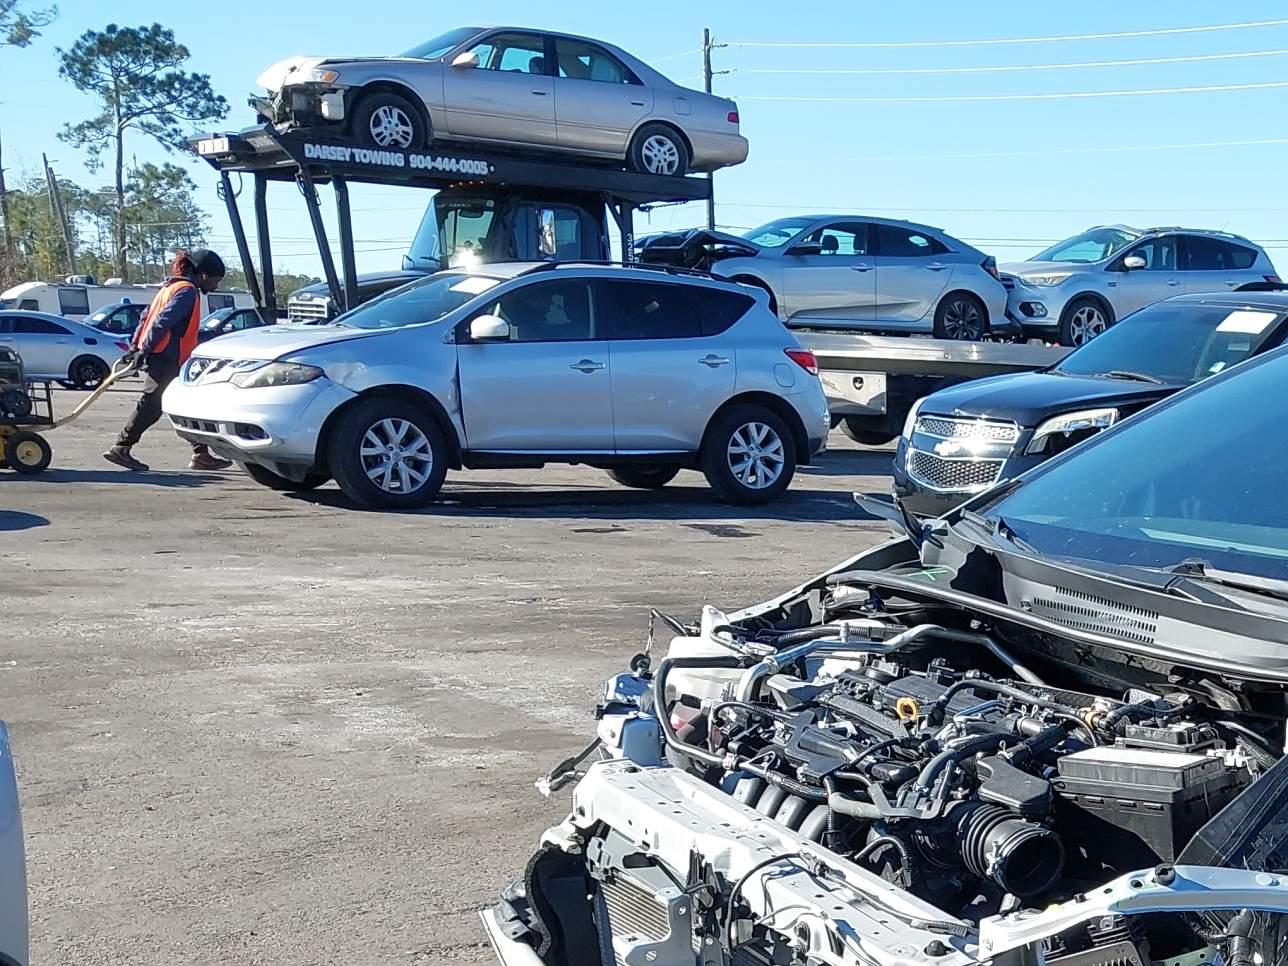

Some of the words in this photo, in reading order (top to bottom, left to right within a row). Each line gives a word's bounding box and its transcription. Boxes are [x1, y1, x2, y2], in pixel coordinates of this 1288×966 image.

[304, 143, 351, 162] DARSEY
[351, 148, 405, 167] TOWING
[409, 154, 488, 176] 904-444-0005
